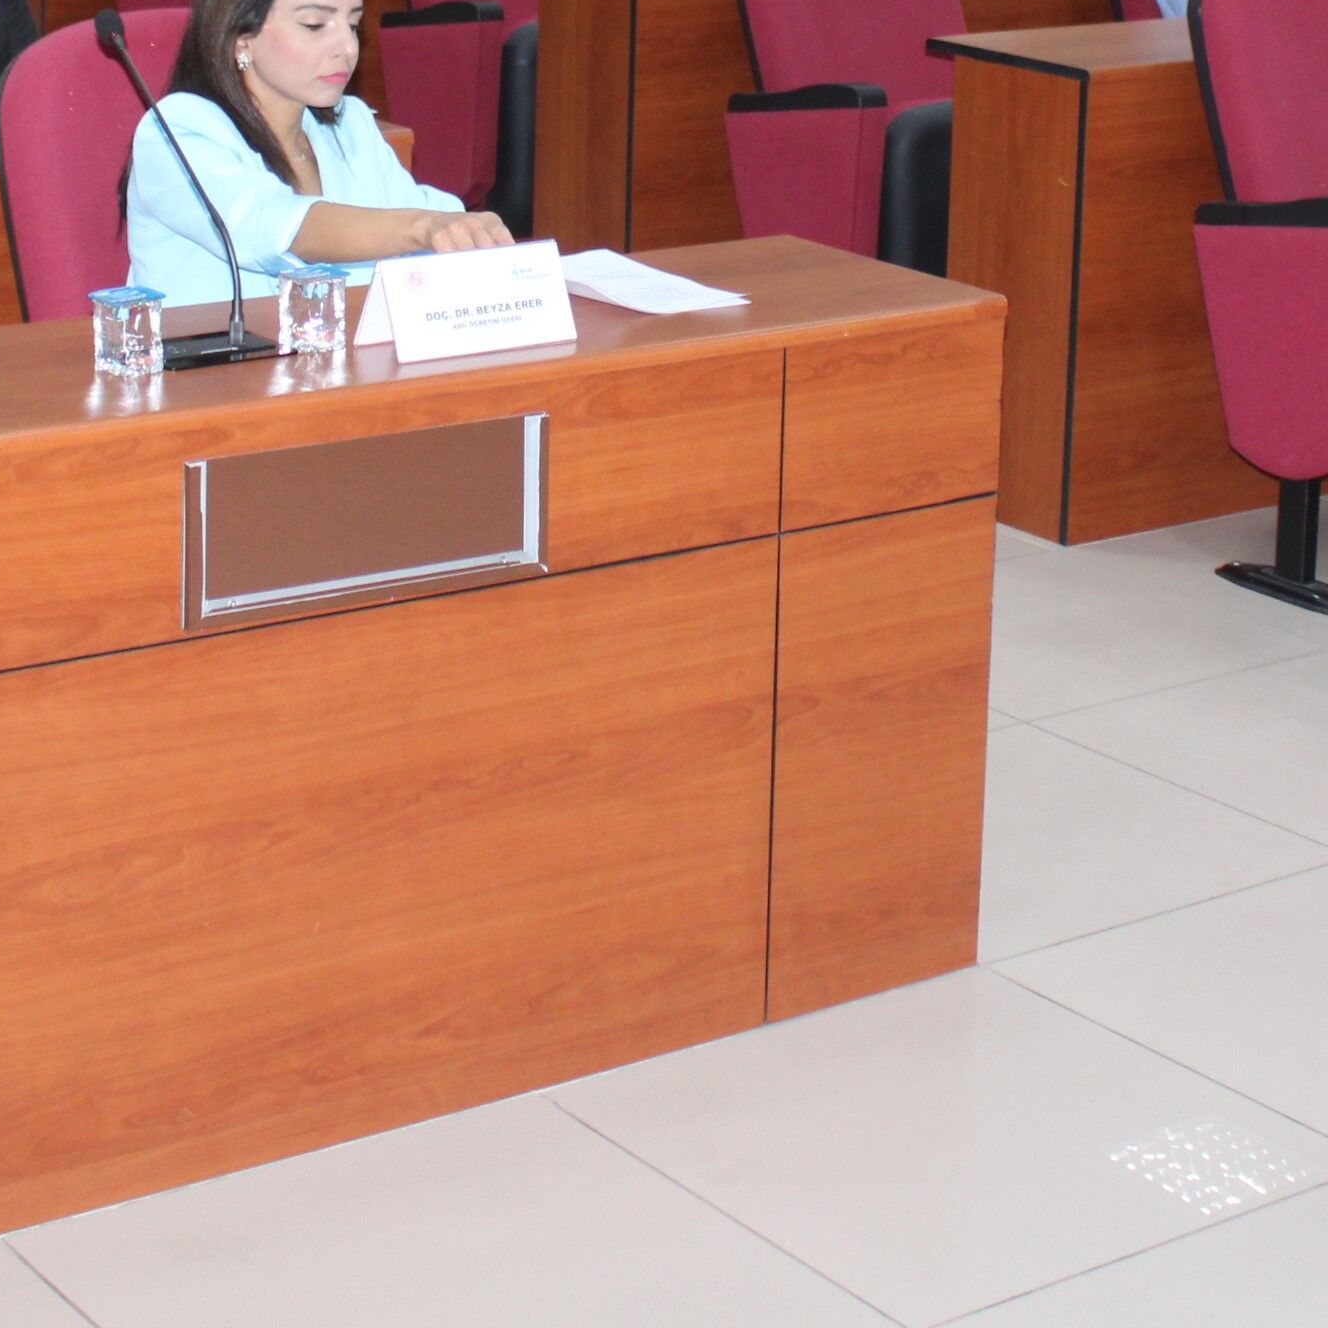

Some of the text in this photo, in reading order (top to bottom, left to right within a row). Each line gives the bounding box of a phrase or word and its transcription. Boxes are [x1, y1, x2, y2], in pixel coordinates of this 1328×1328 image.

[425, 298, 543, 322] DOÇ. DR. BEYZA ERER
